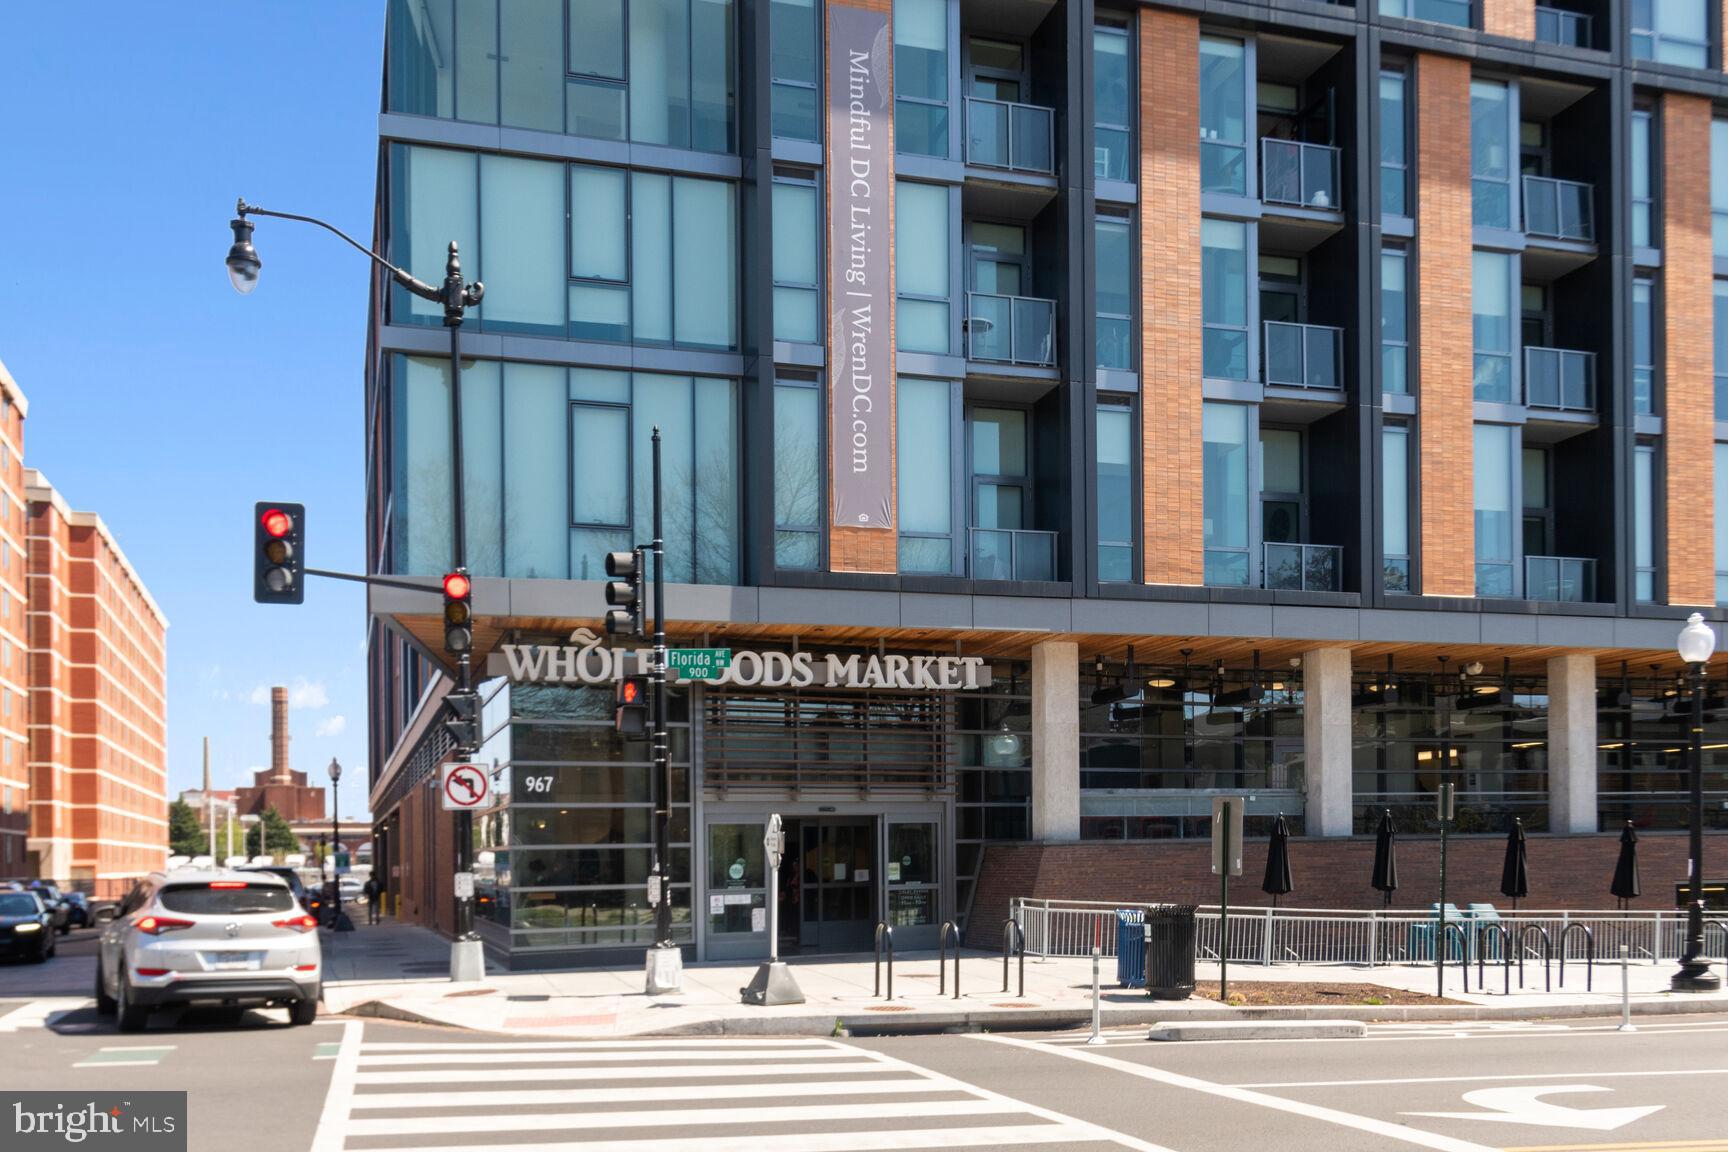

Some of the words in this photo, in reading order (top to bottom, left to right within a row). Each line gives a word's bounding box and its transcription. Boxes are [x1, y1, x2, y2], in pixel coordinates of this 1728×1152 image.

[849, 49, 871, 150] Mindful
[850, 157, 871, 198] DC
[845, 204, 872, 285] Living
[851, 304, 872, 473] WrenDC.com
[671, 652, 711, 666] Florida
[714, 650, 725, 658] AVE
[689, 667, 708, 678] 900
[824, 653, 984, 690] MARKET
[525, 776, 554, 792] 967
